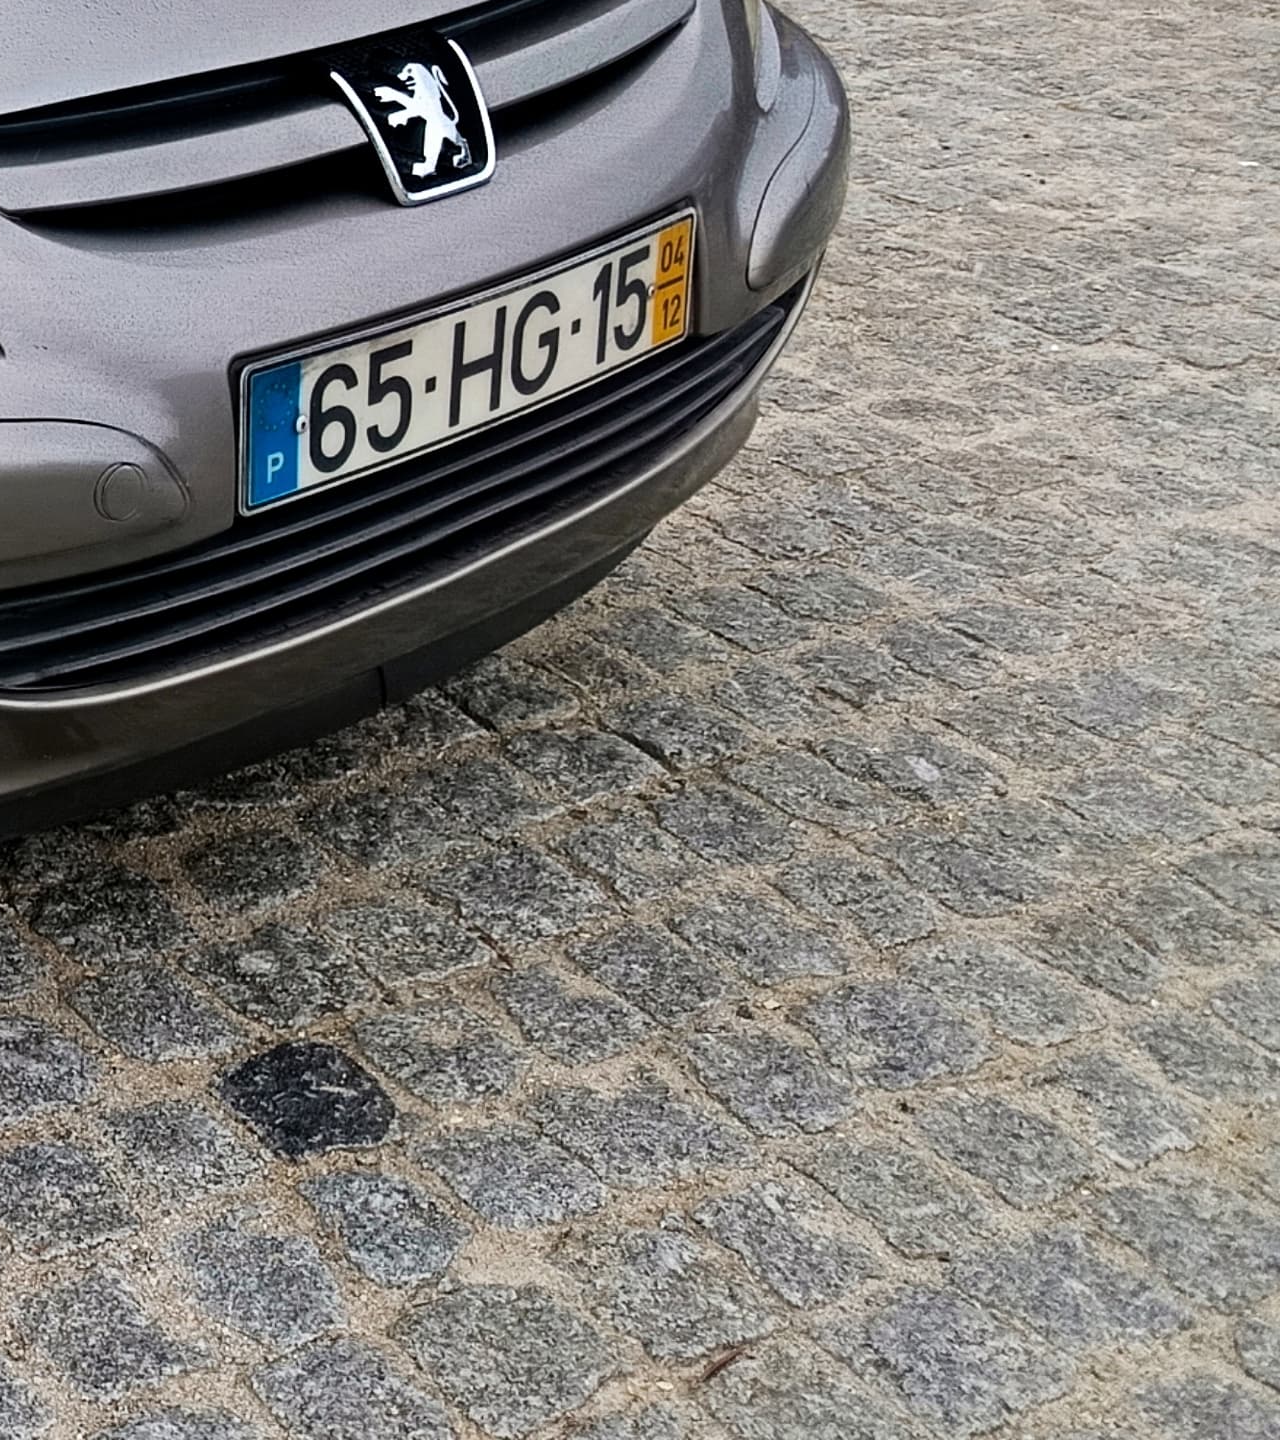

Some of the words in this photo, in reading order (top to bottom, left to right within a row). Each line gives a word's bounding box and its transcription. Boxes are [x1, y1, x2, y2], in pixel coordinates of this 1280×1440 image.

[661, 235, 685, 273] 04
[662, 293, 682, 330] 12
[267, 451, 285, 484] P
